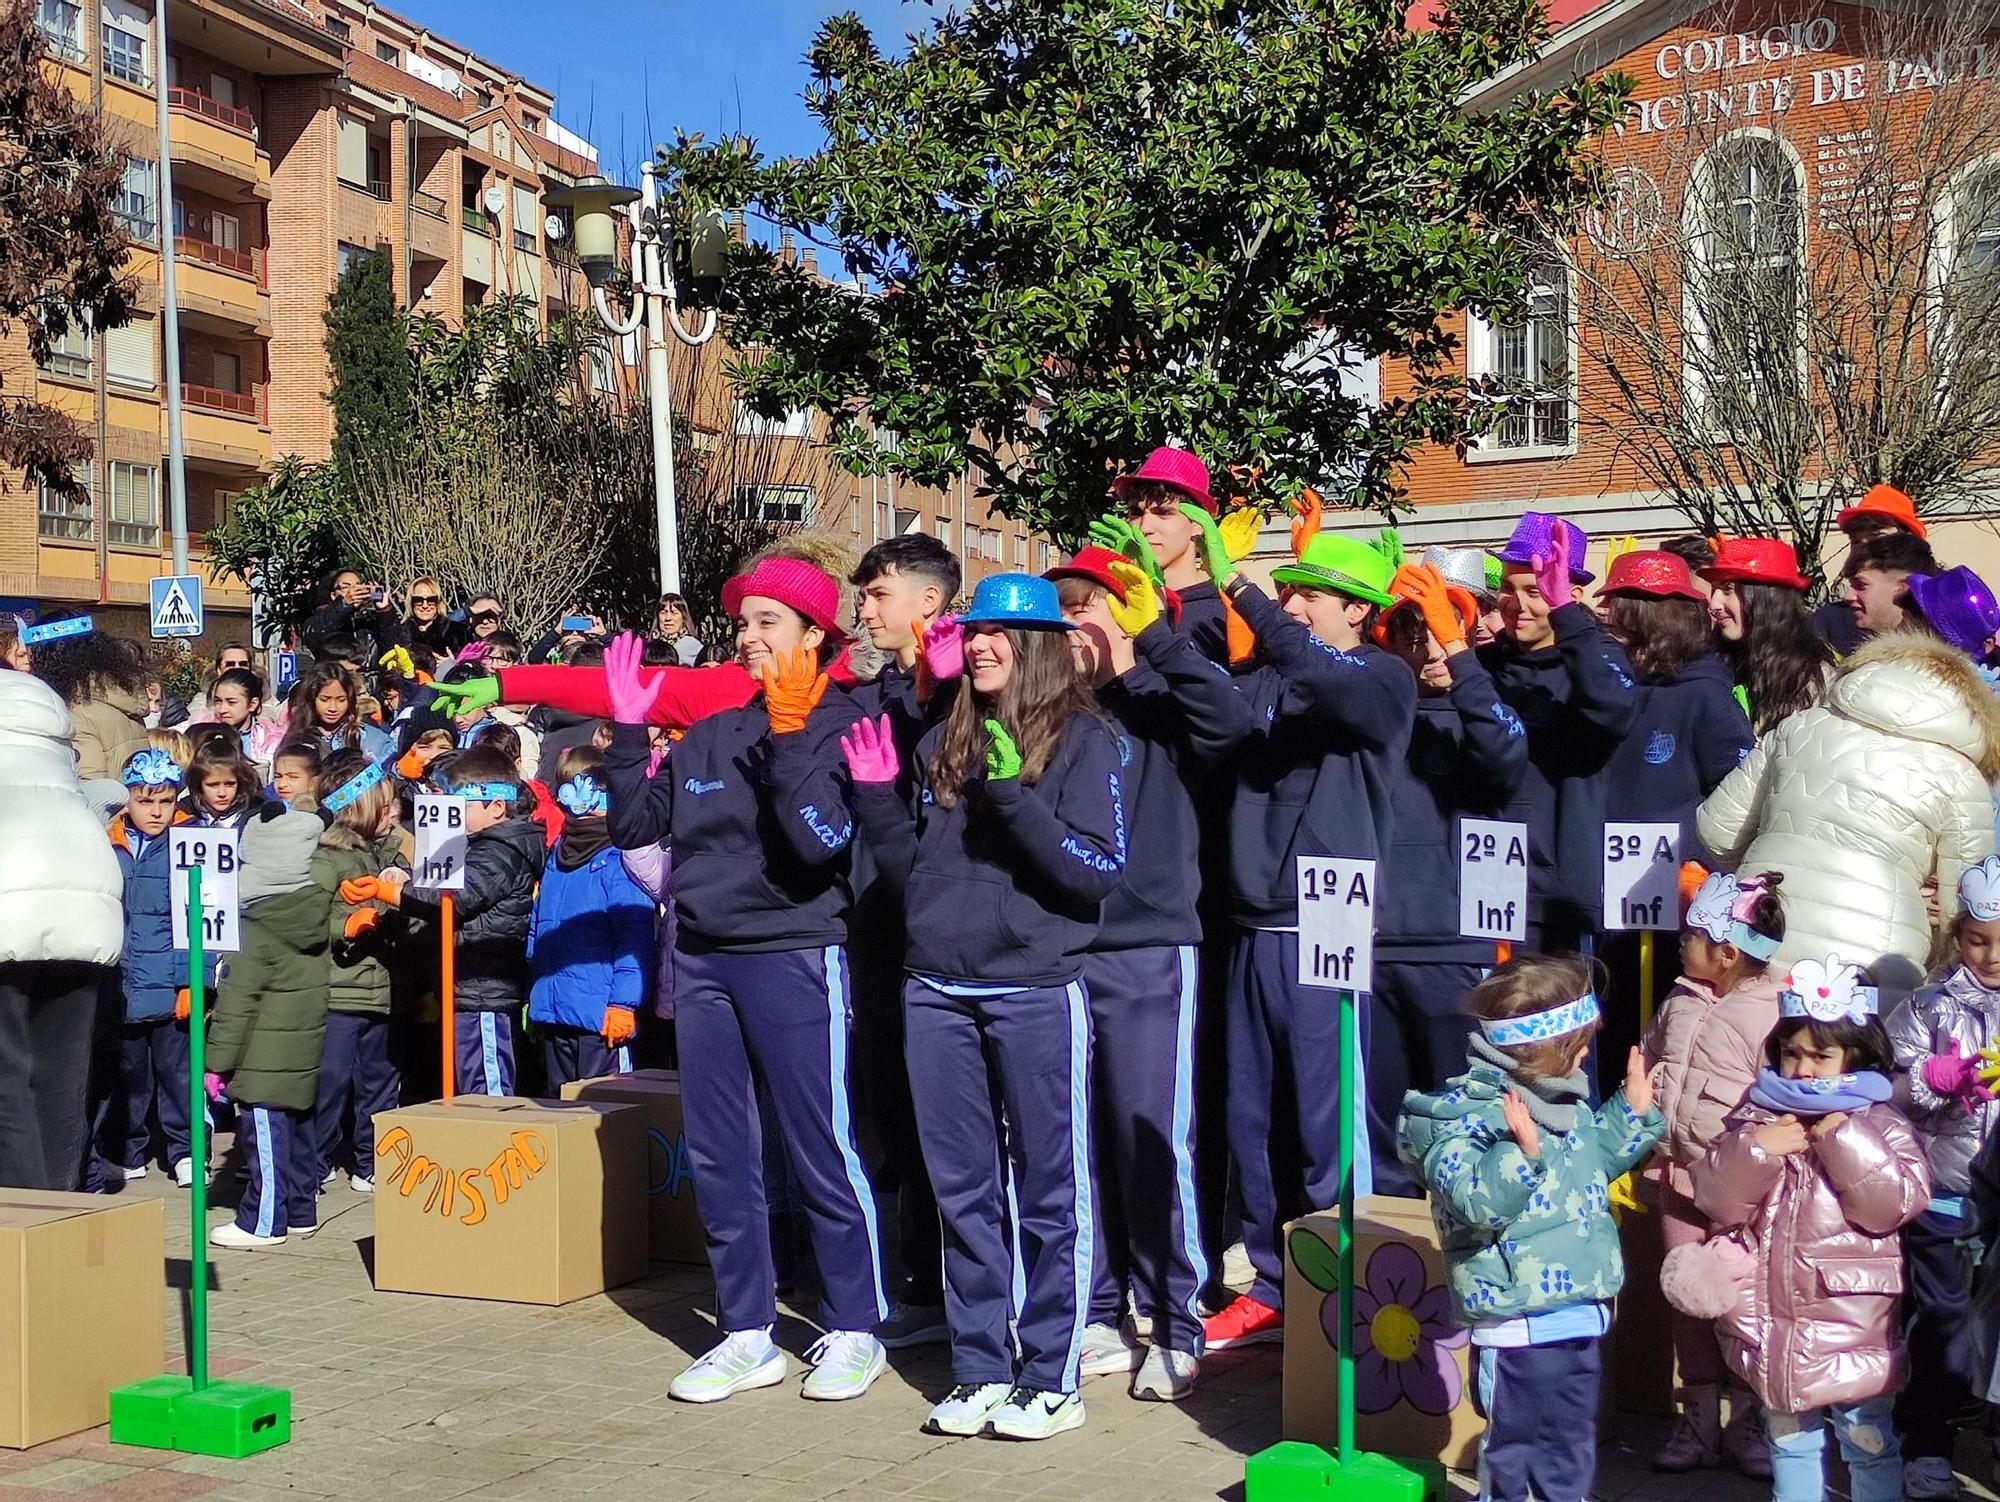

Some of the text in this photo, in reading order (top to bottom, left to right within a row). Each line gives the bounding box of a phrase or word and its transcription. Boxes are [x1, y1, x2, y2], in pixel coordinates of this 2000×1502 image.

[1656, 17, 1836, 80] COLEGIO
[1809, 63, 1866, 106] DE
[281, 656, 292, 682] P
[418, 805, 462, 828] 2º B
[176, 841, 235, 874] 1º B
[1465, 833, 1526, 867] 2º A
[1607, 835, 1675, 864] 3º A
[423, 856, 454, 881] Inf
[1303, 867, 1370, 907] 1º A
[1477, 900, 1515, 933] Inf
[1621, 896, 1663, 926] Inf
[1976, 902, 1999, 912] PAZ
[186, 909, 225, 942] nf
[1313, 944, 1355, 982] Inf
[1810, 1001, 1838, 1015] PAZ
[375, 1125, 550, 1227] AMISTAD
